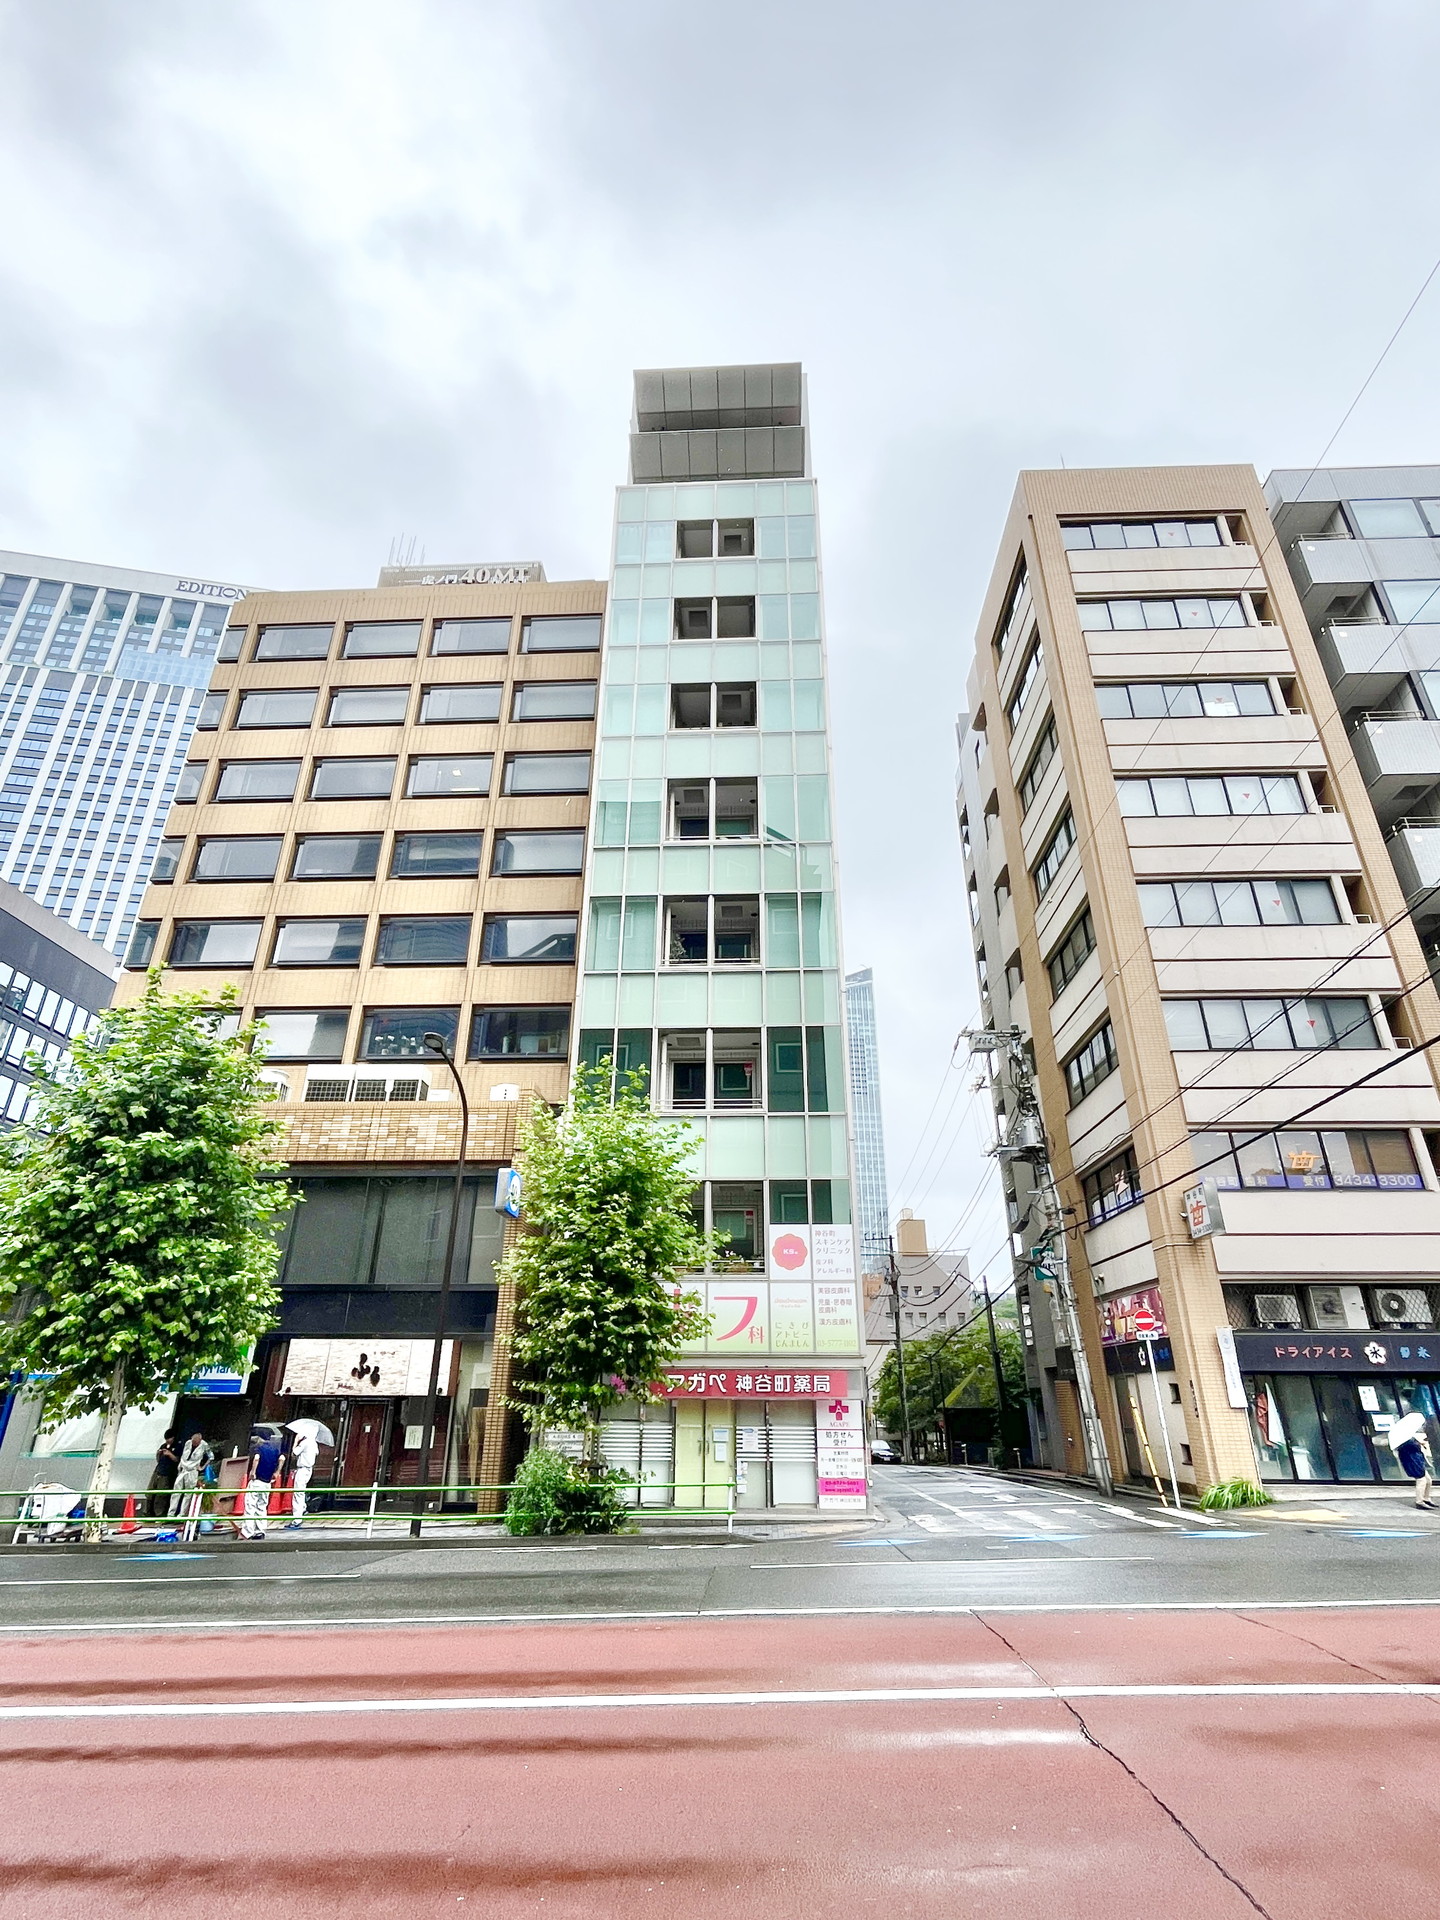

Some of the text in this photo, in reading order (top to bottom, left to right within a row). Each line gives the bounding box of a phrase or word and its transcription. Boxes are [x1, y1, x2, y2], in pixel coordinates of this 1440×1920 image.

[175, 581, 249, 600] EDITION
[1303, 1176, 1325, 1187] 受付
[1275, 1346, 1352, 1359] ドライアイス
[667, 1373, 830, 1393] アガペ 神谷町薬局
[826, 1431, 853, 1439] 処方せん
